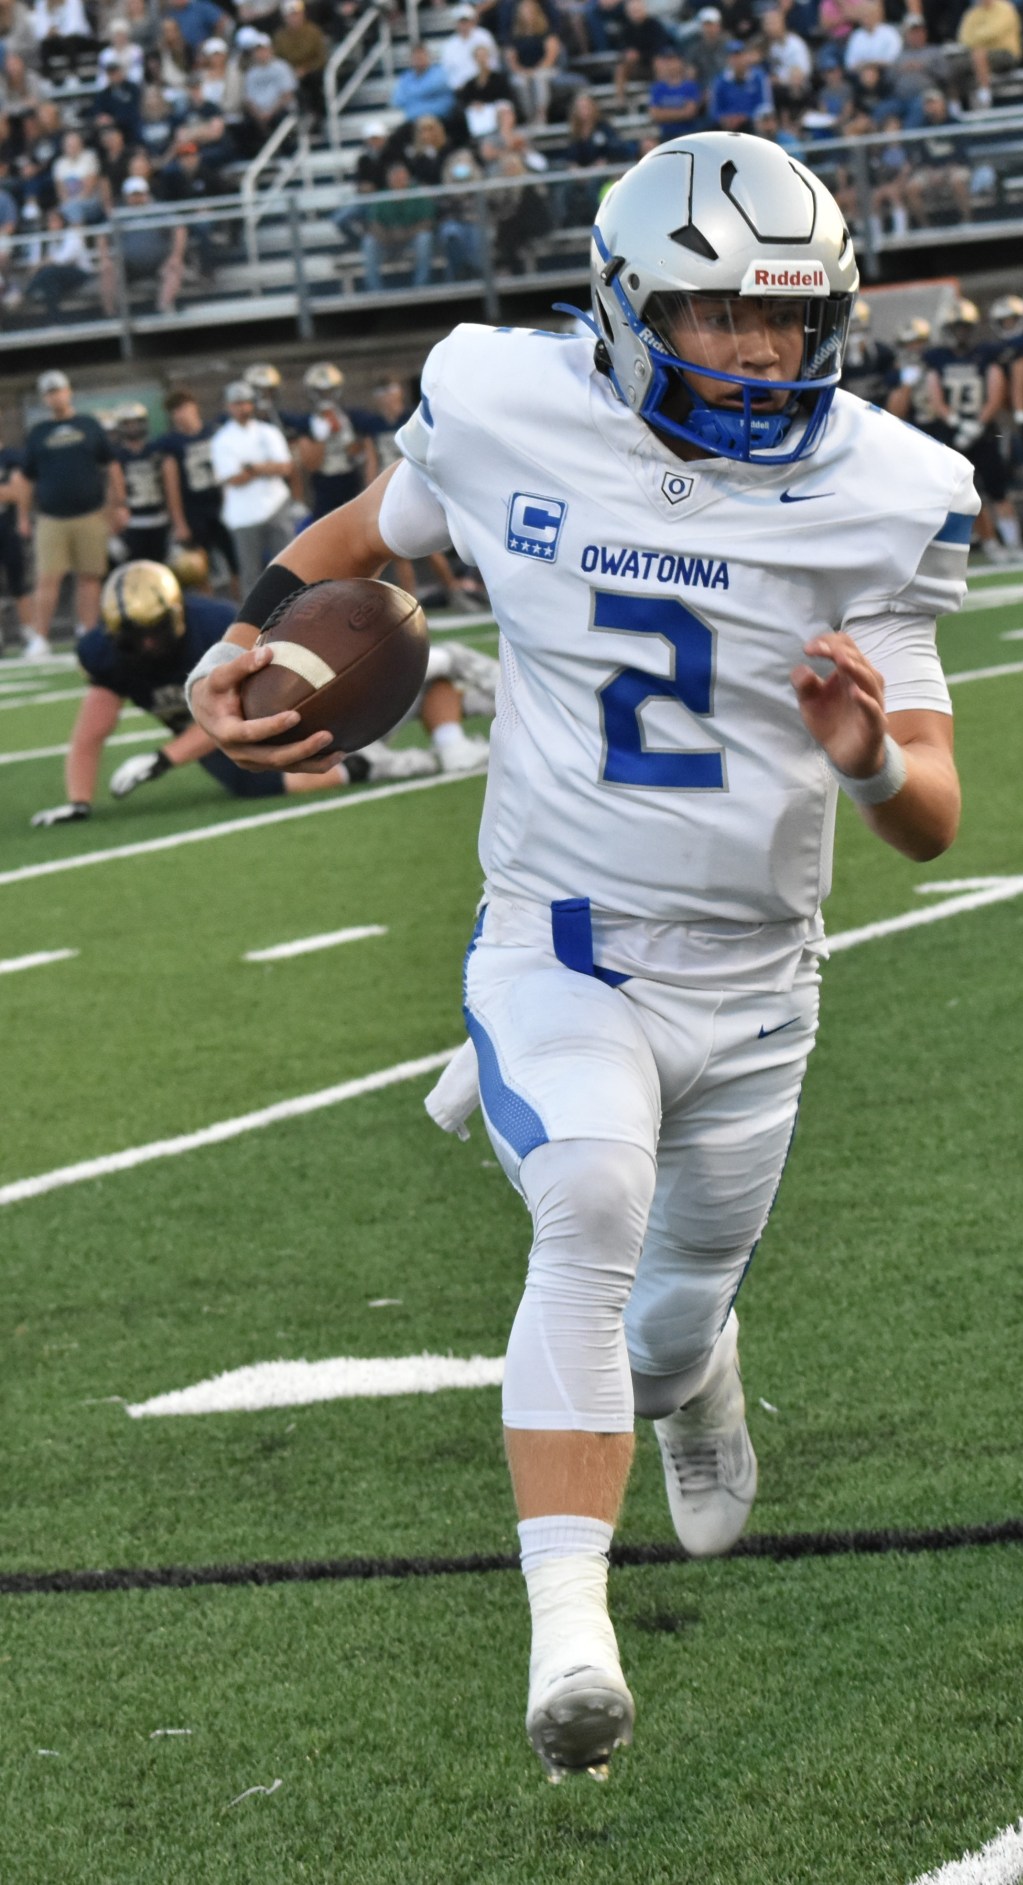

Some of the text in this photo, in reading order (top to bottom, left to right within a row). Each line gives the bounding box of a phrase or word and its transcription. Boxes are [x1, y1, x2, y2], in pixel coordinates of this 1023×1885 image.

[754, 269, 824, 287] Riddell
[511, 495, 562, 544] C
[580, 545, 730, 590] OWATONNA
[588, 585, 730, 793] 2
